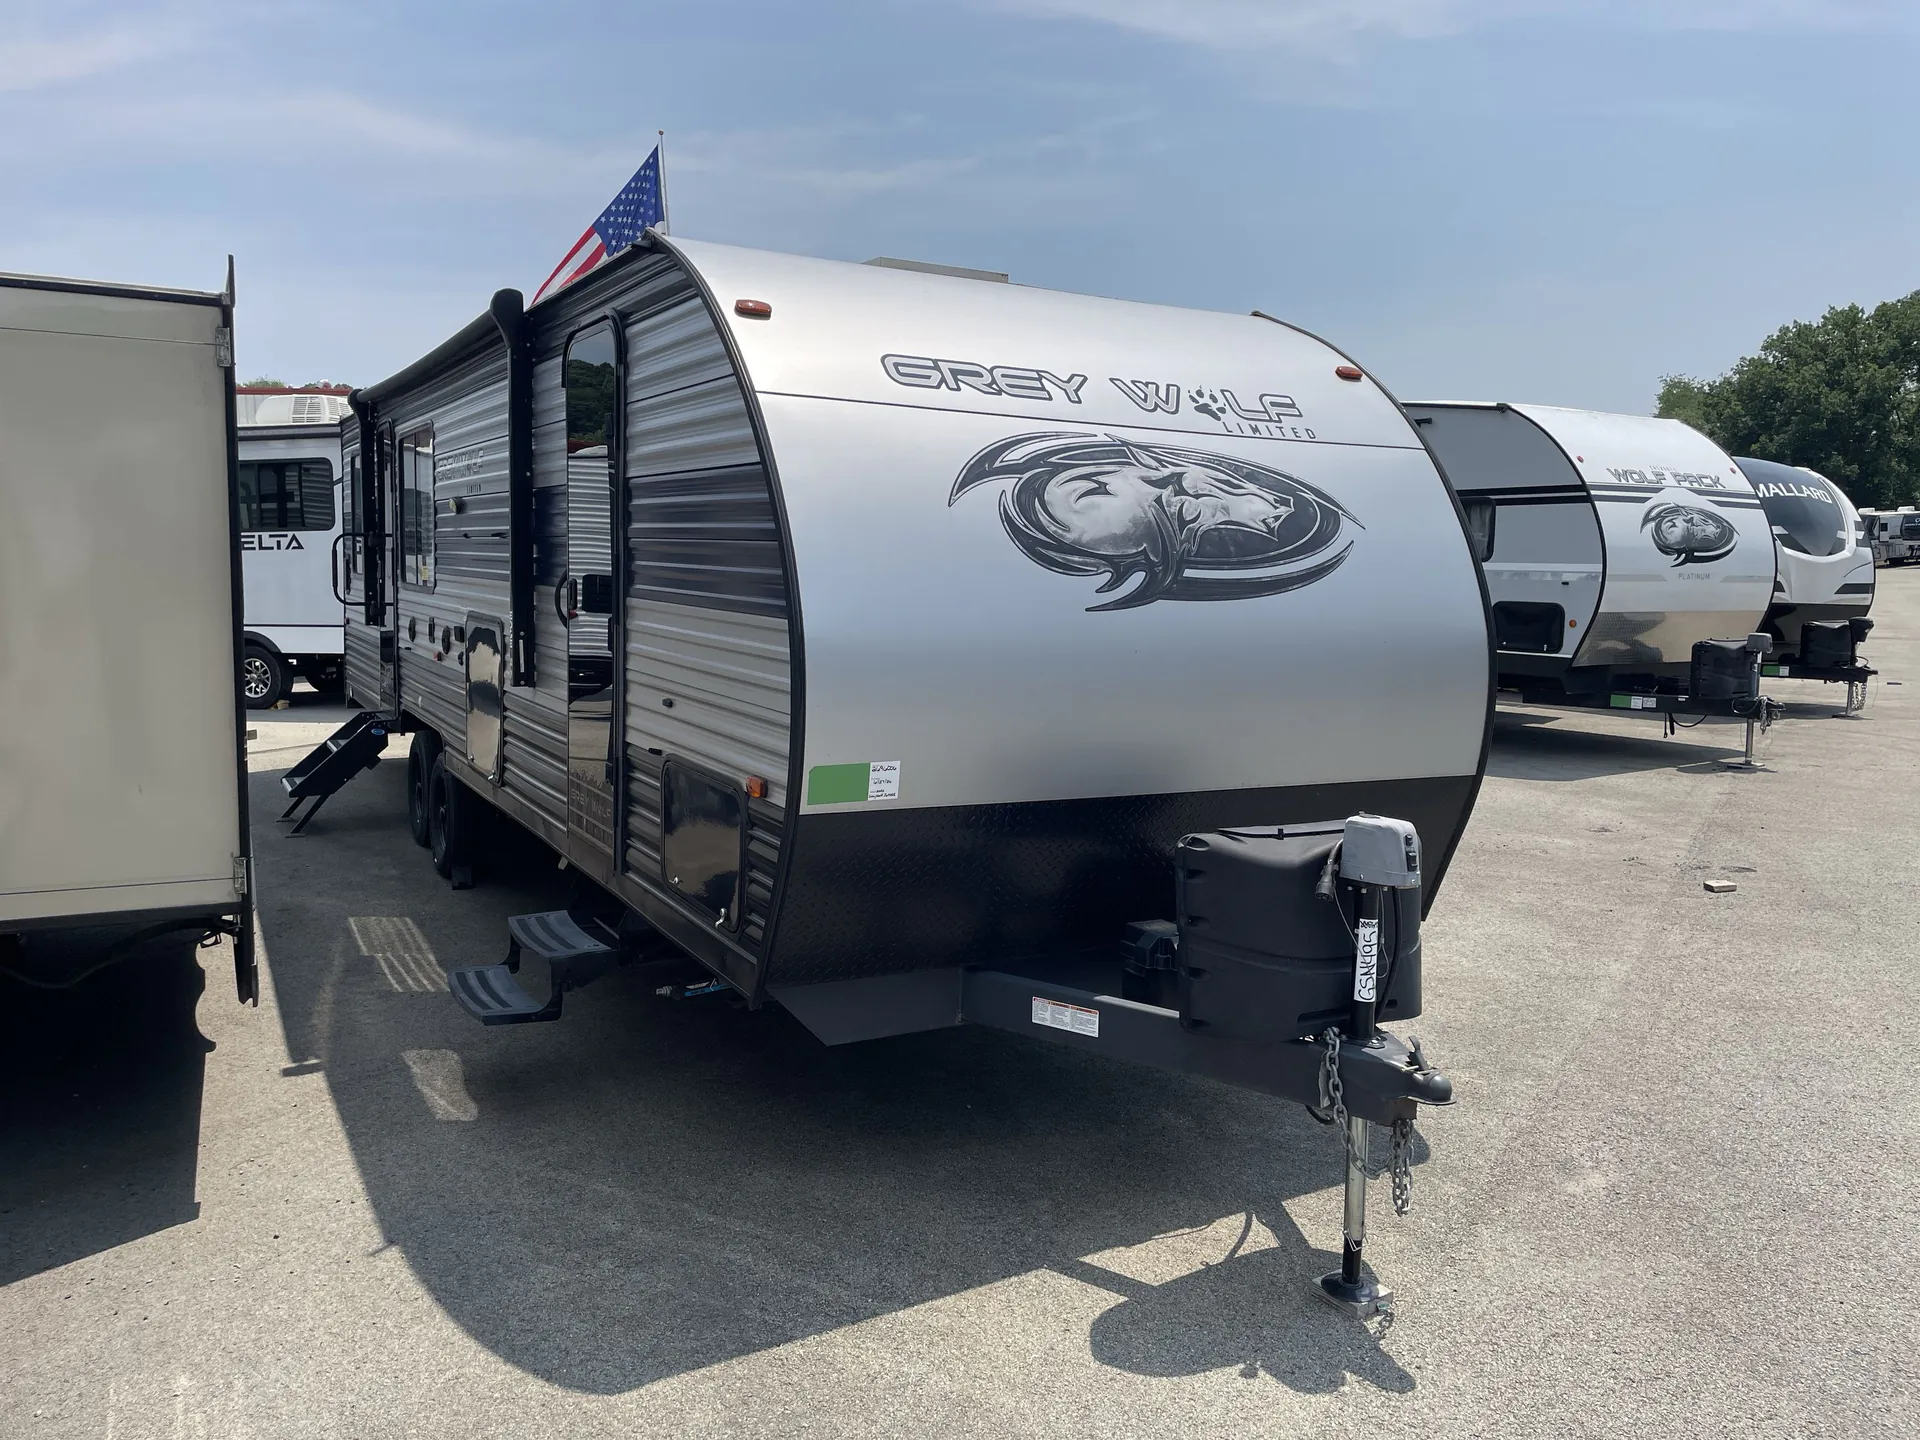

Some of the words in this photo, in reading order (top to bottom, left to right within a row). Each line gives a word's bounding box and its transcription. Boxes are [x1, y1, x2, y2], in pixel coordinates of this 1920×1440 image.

[880, 352, 1088, 405] GREY
[1222, 421, 1316, 439] LIMITED
[1606, 467, 1667, 485] WOLF
[1670, 472, 1726, 489] PACK
[1678, 572, 1710, 580] PLATINUM
[1358, 931, 1376, 1002] GSN495
